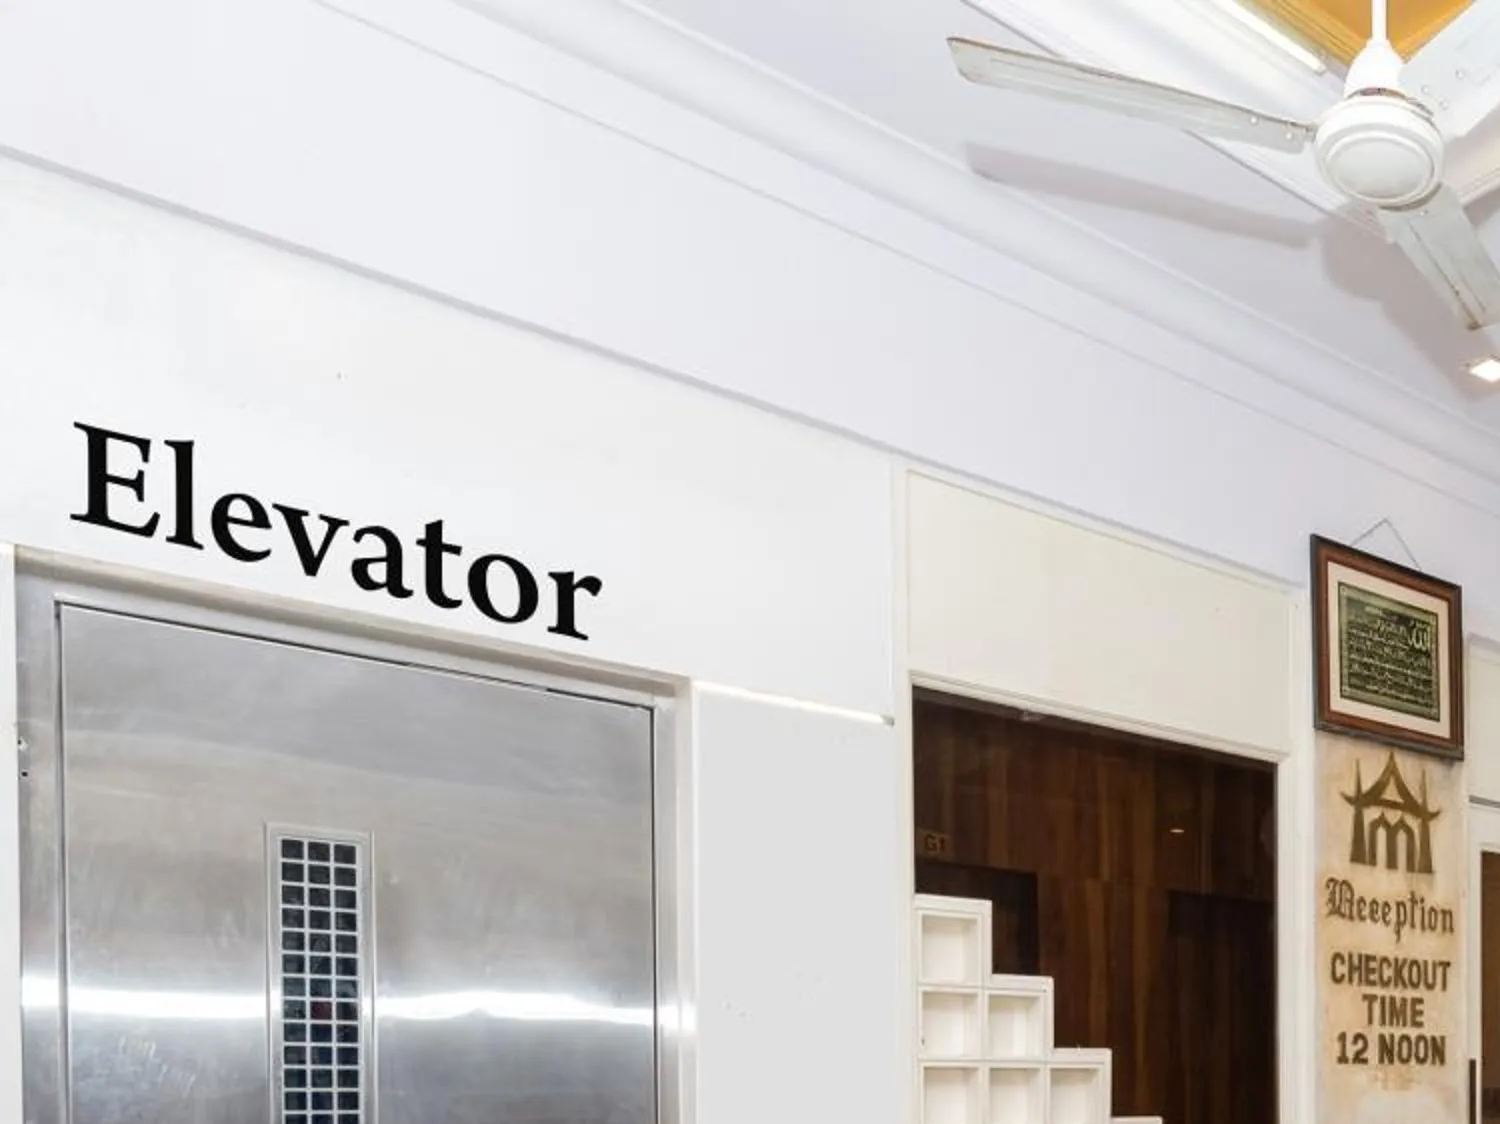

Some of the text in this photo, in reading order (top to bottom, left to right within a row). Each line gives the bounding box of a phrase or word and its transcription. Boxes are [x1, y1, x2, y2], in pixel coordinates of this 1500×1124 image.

[69, 421, 603, 641] Elevator
[1325, 876, 1455, 944] Reception
[1330, 952, 1452, 992] CHECKOUT
[1361, 993, 1425, 1029] TIME
[1336, 1031, 1447, 1067] 12 NOON
